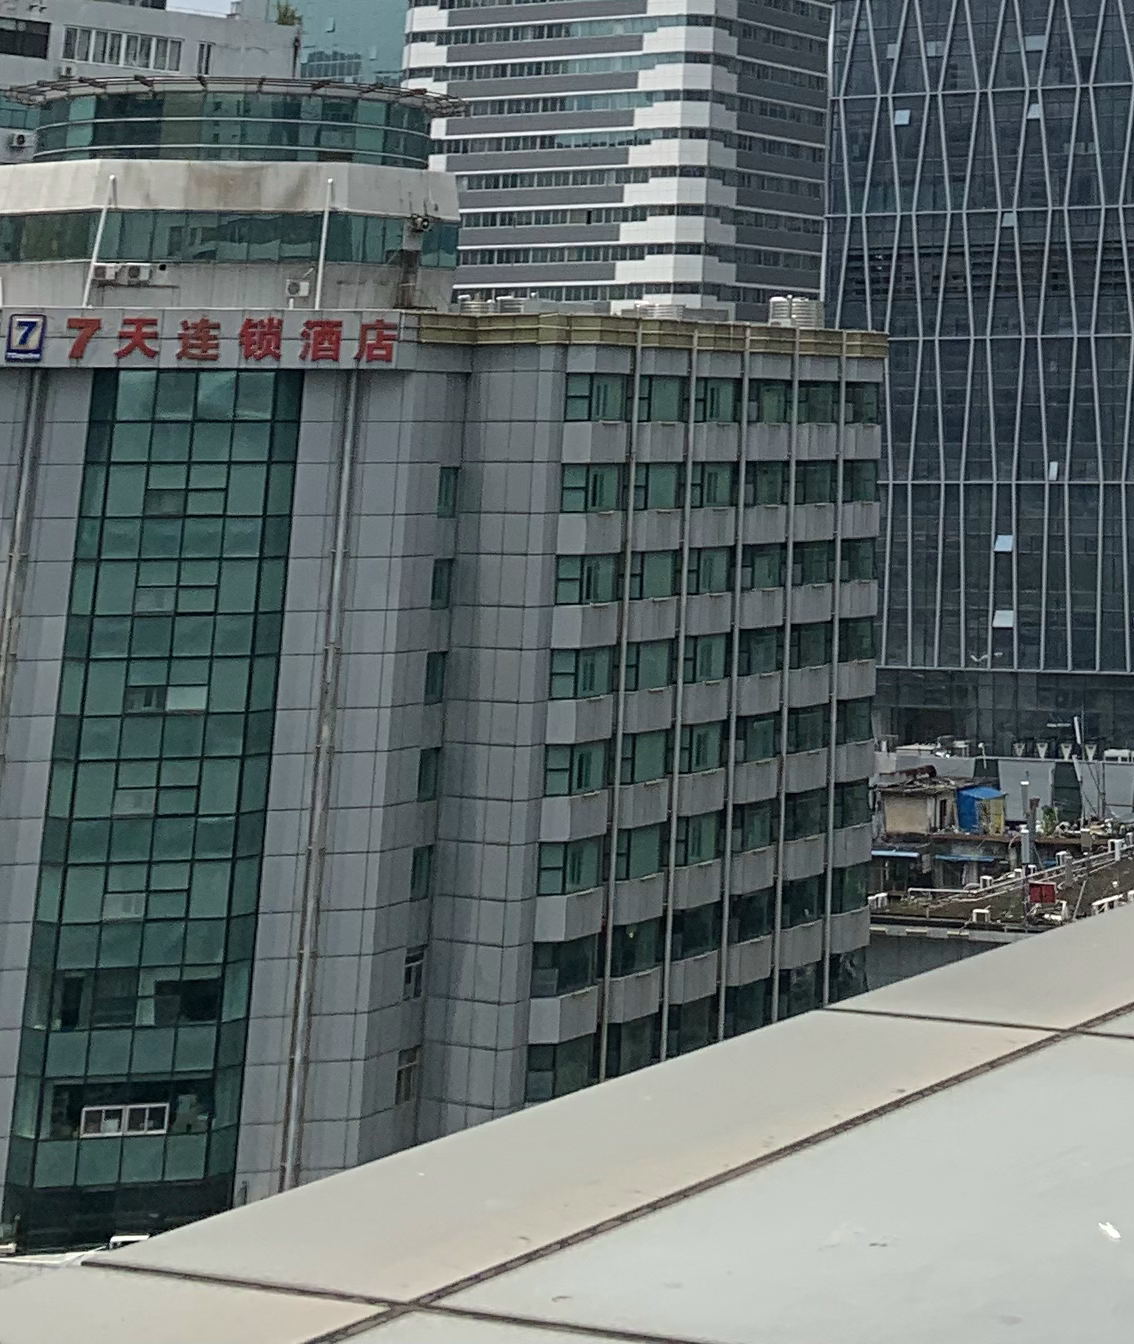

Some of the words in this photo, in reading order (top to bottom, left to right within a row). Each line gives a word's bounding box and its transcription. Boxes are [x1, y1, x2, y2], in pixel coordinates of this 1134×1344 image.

[17, 320, 38, 345] 7
[66, 317, 400, 363] 7天连锁酒店
